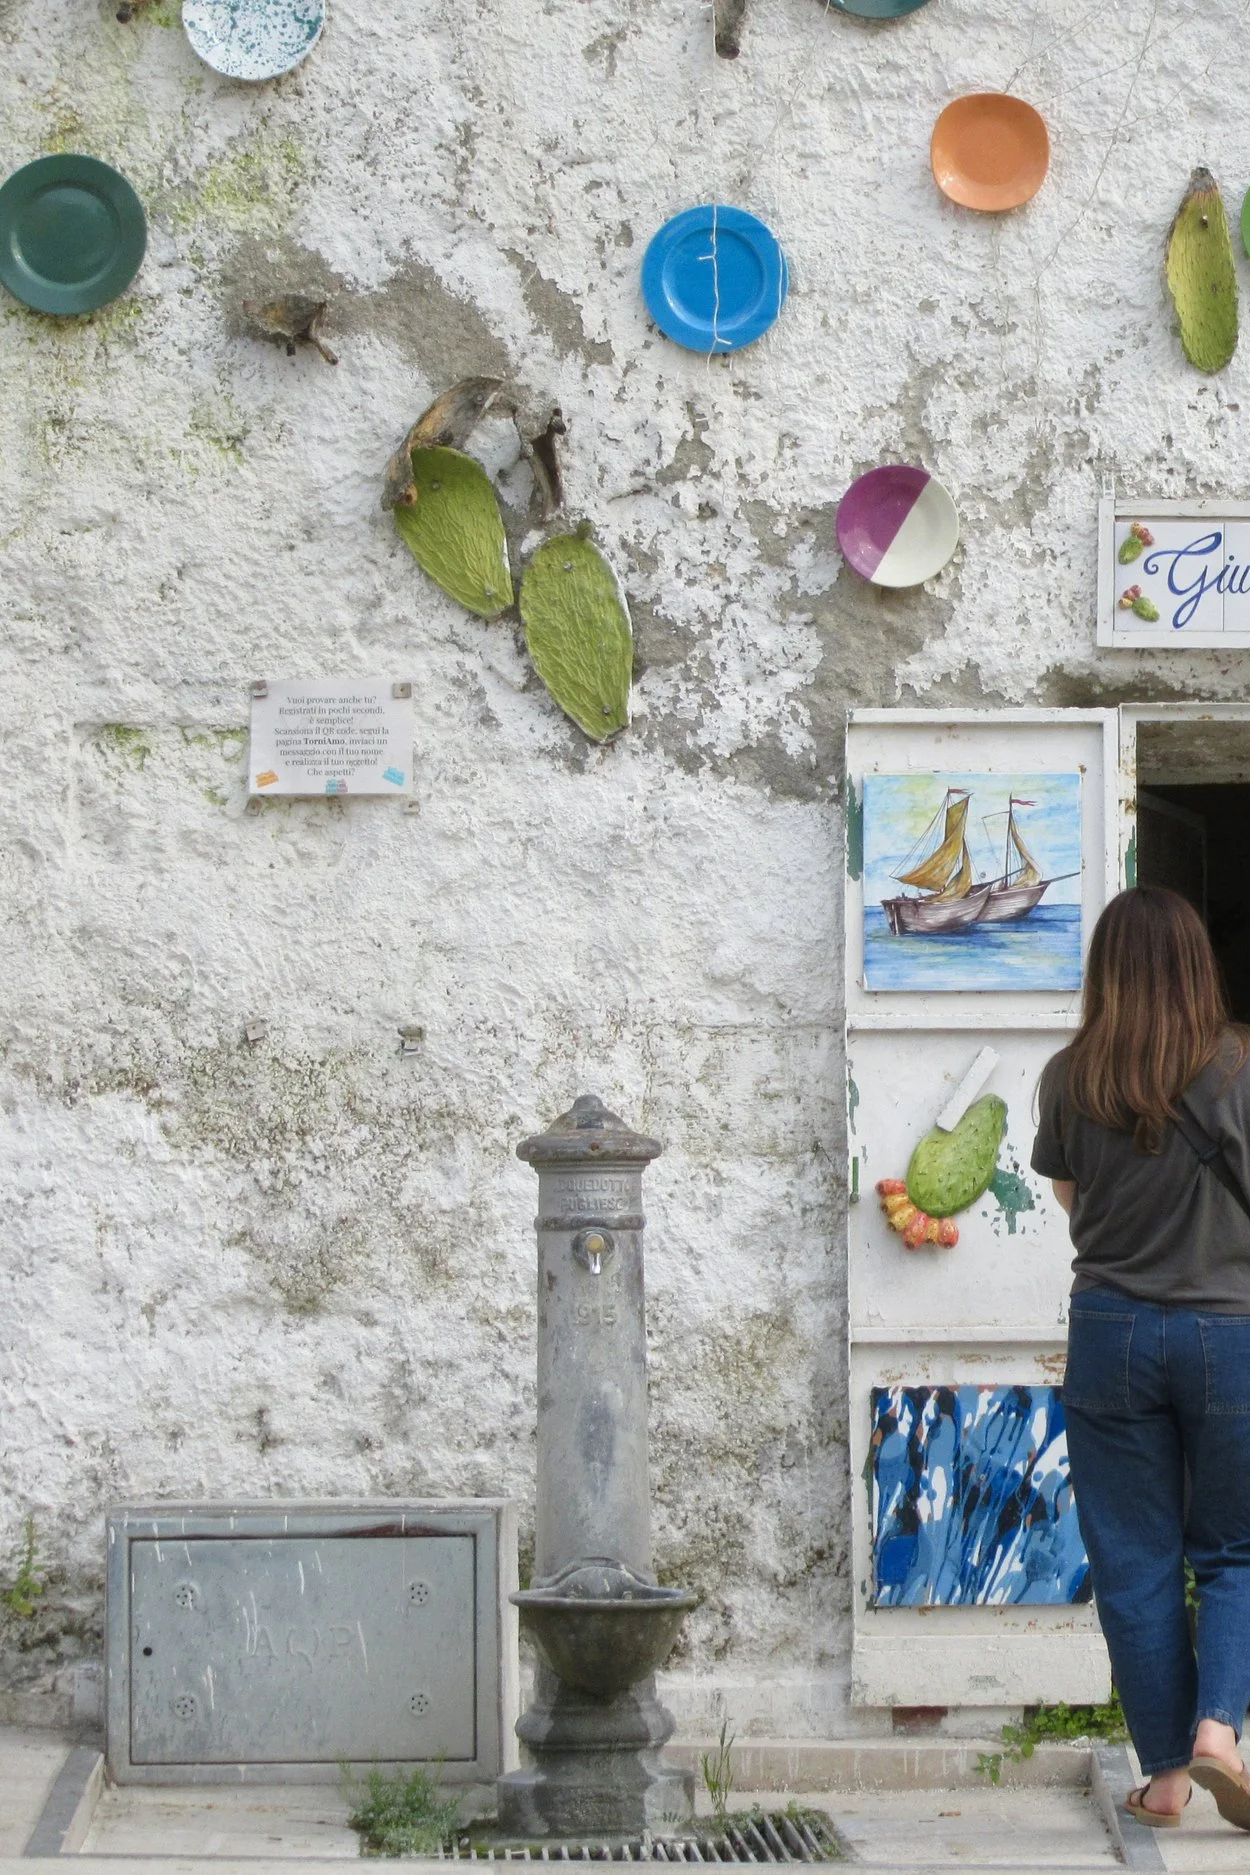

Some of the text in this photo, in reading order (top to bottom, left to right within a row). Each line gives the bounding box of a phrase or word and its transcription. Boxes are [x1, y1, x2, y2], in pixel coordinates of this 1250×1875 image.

[287, 696, 377, 705] Vuoi provare anche tu?
[279, 707, 317, 715] Registrati
[328, 707, 350, 715] pochi
[316, 717, 354, 726] semplice!
[274, 727, 313, 735] Scansiona
[315, 727, 321, 735] il
[322, 727, 335, 736] QR
[359, 727, 381, 736] segui
[382, 727, 389, 735] la
[276, 738, 302, 747] pagina
[280, 748, 321, 757] messaggio
[291, 758, 322, 766] realizza
[346, 758, 378, 767] oggetto!
[307, 768, 356, 777] Che aspetti?
[249, 1625, 353, 1674] AQP
